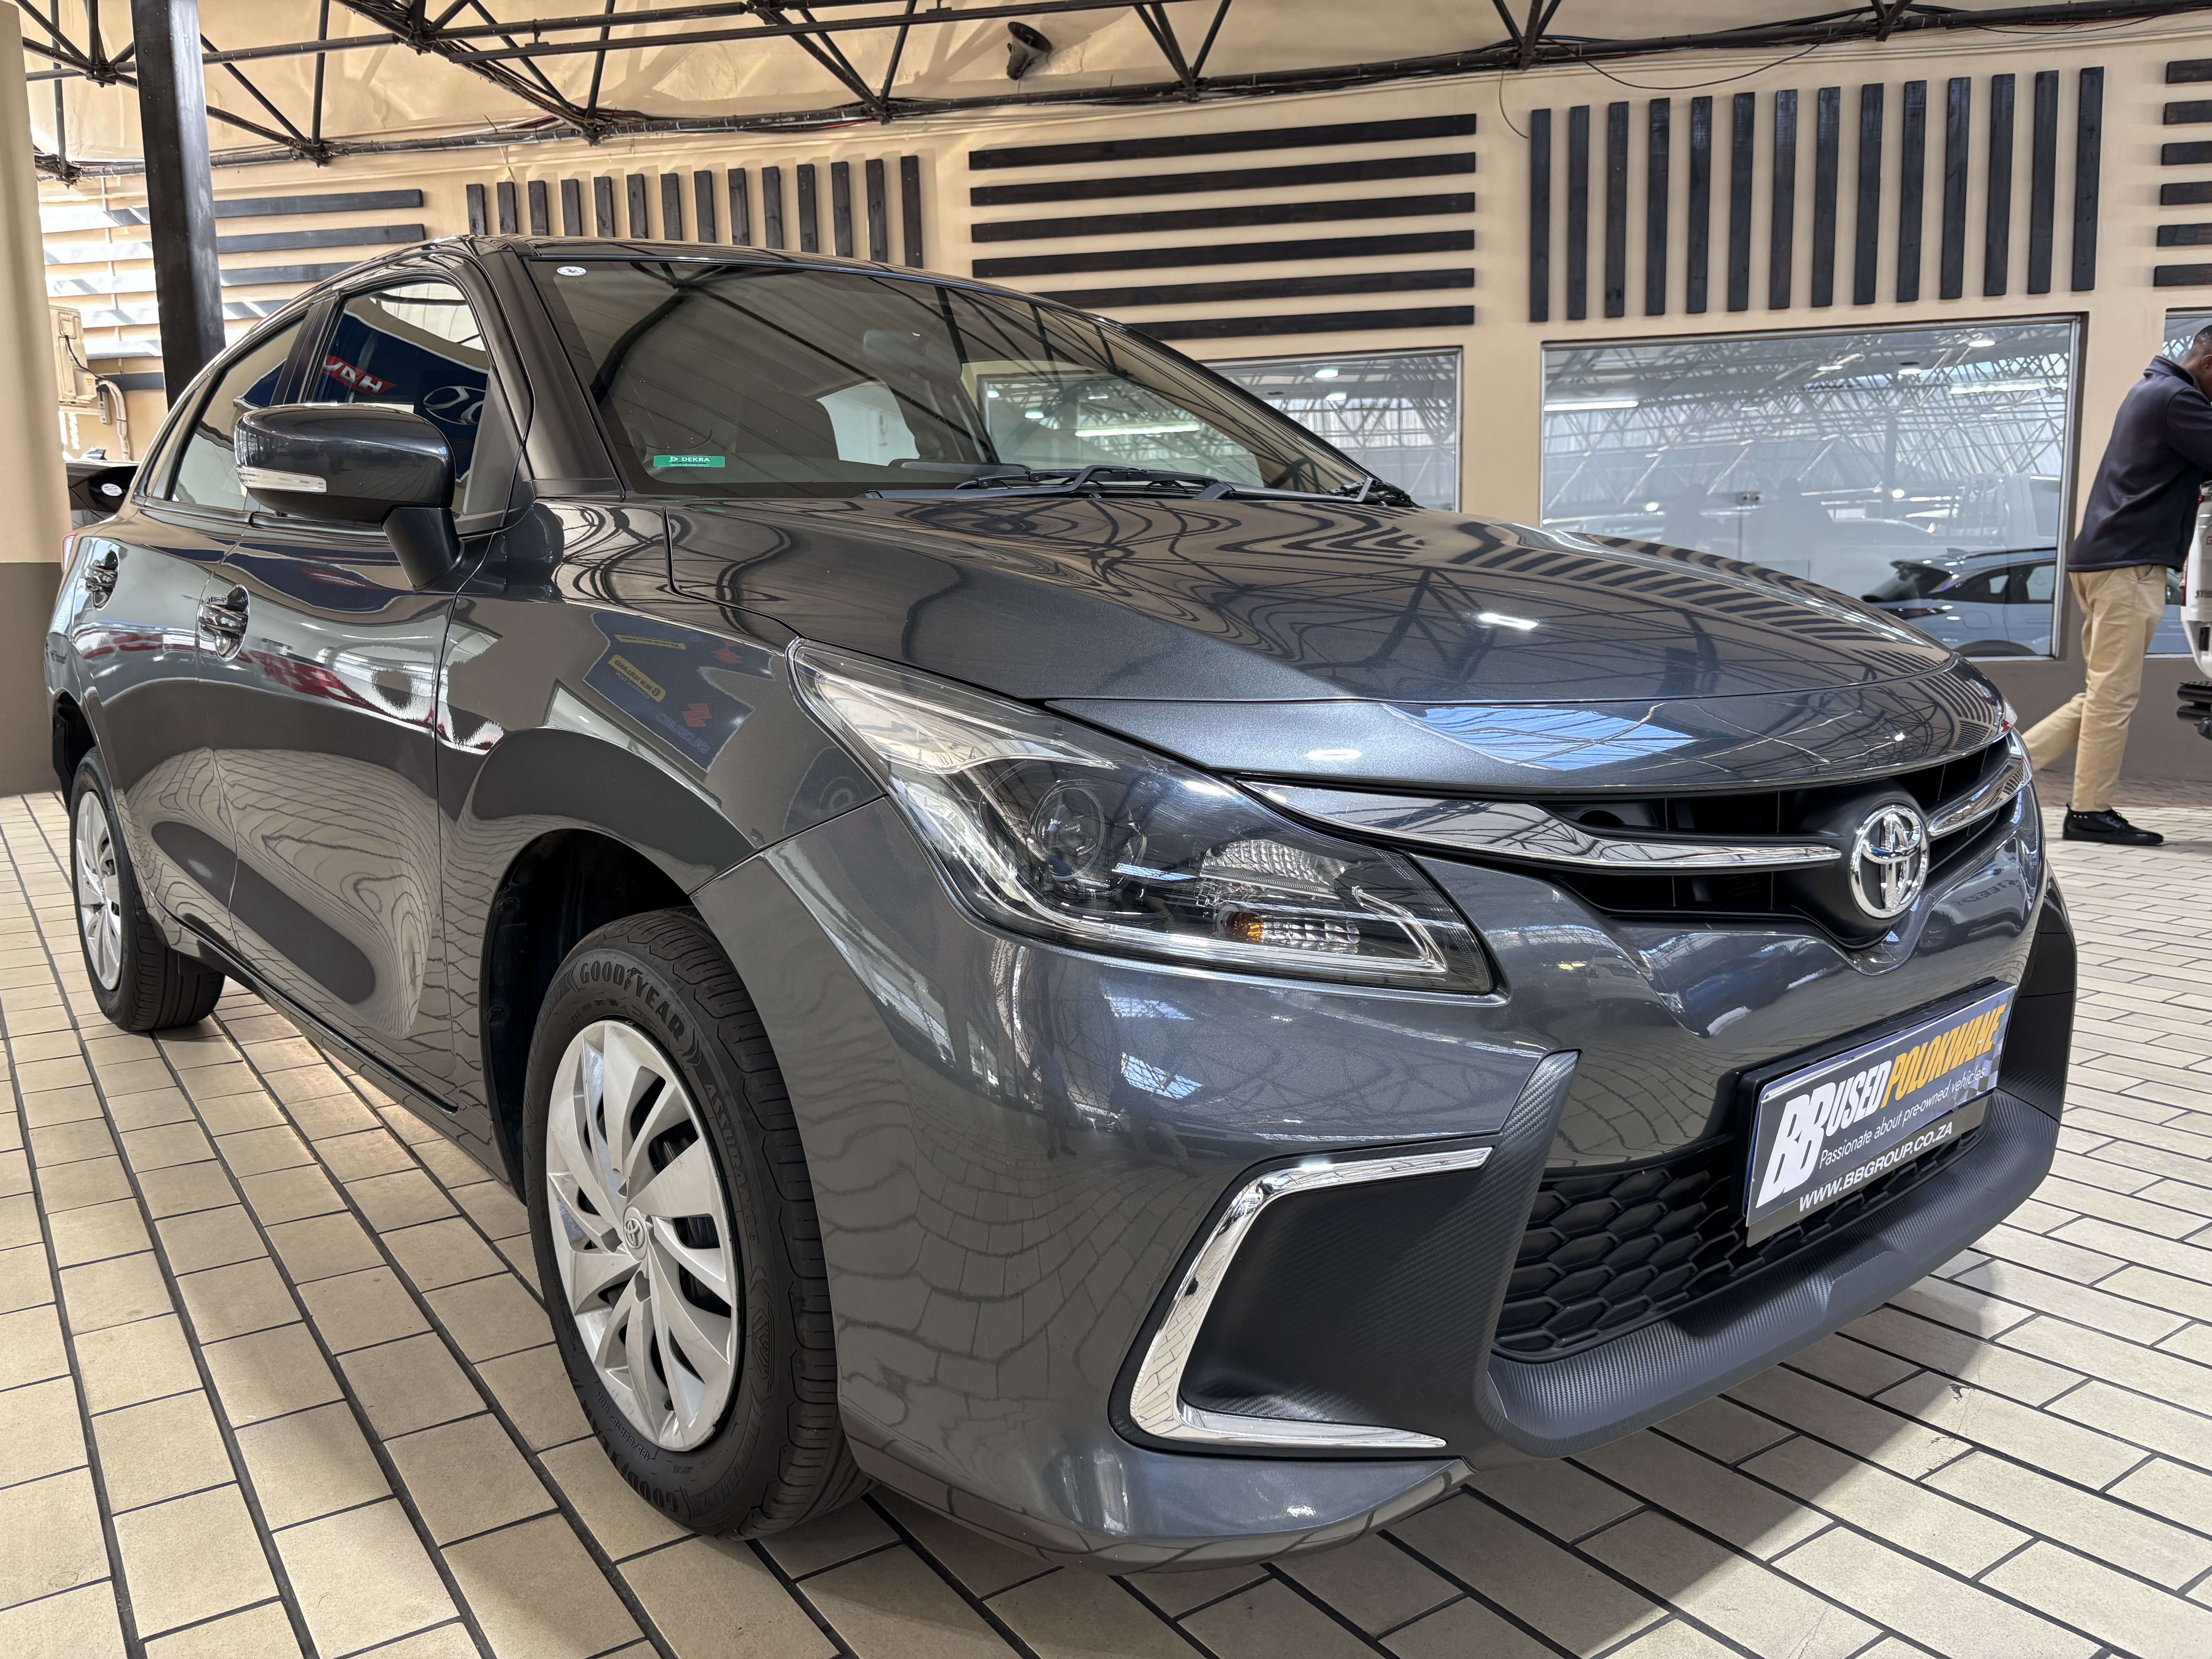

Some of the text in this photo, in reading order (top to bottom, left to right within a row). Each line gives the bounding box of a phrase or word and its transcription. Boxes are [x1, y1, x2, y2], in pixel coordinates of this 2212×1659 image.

[580, 960, 685, 1042] GOODYEAR
[704, 1084, 759, 1244] ASSURANCE
[1819, 1065, 1986, 1169] Passionate about pre-owned vehicles
[1799, 1121, 1953, 1212] WWW.BBGROUP.CO.ZA
